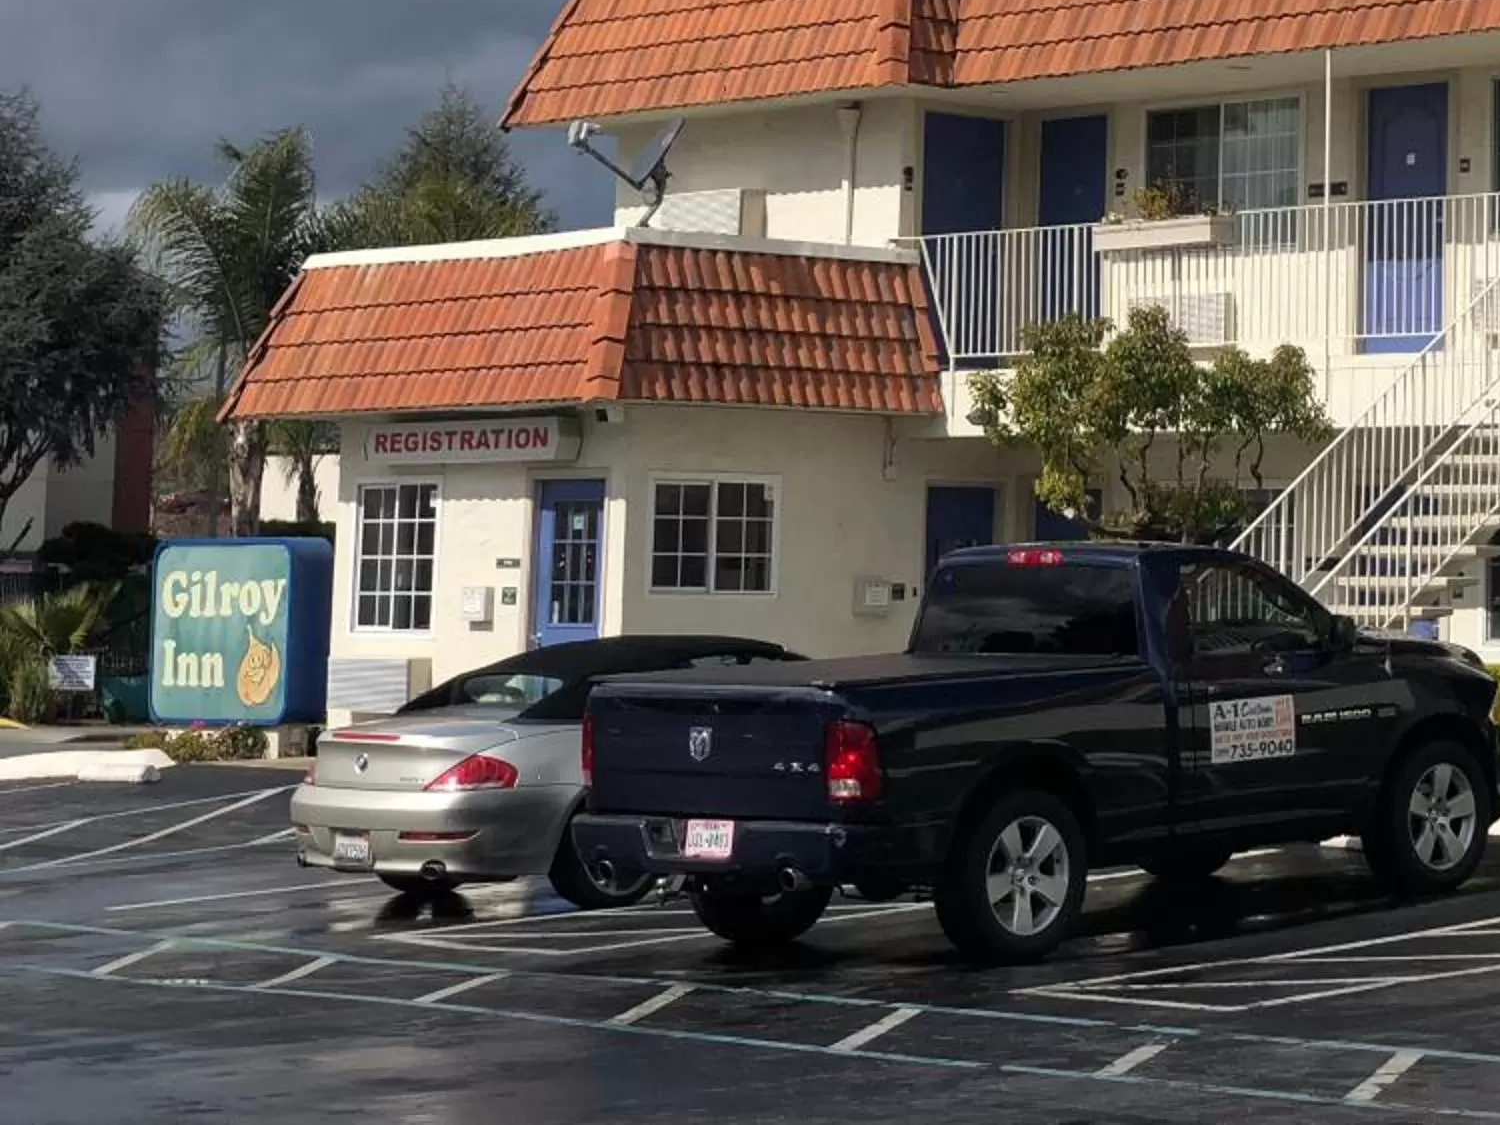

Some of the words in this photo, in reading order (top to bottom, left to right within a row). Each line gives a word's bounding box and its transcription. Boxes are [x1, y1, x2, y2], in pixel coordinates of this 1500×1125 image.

[374, 426, 549, 455] REGISTRATION
[161, 570, 287, 625] Gilroy
[161, 639, 225, 688] Inn
